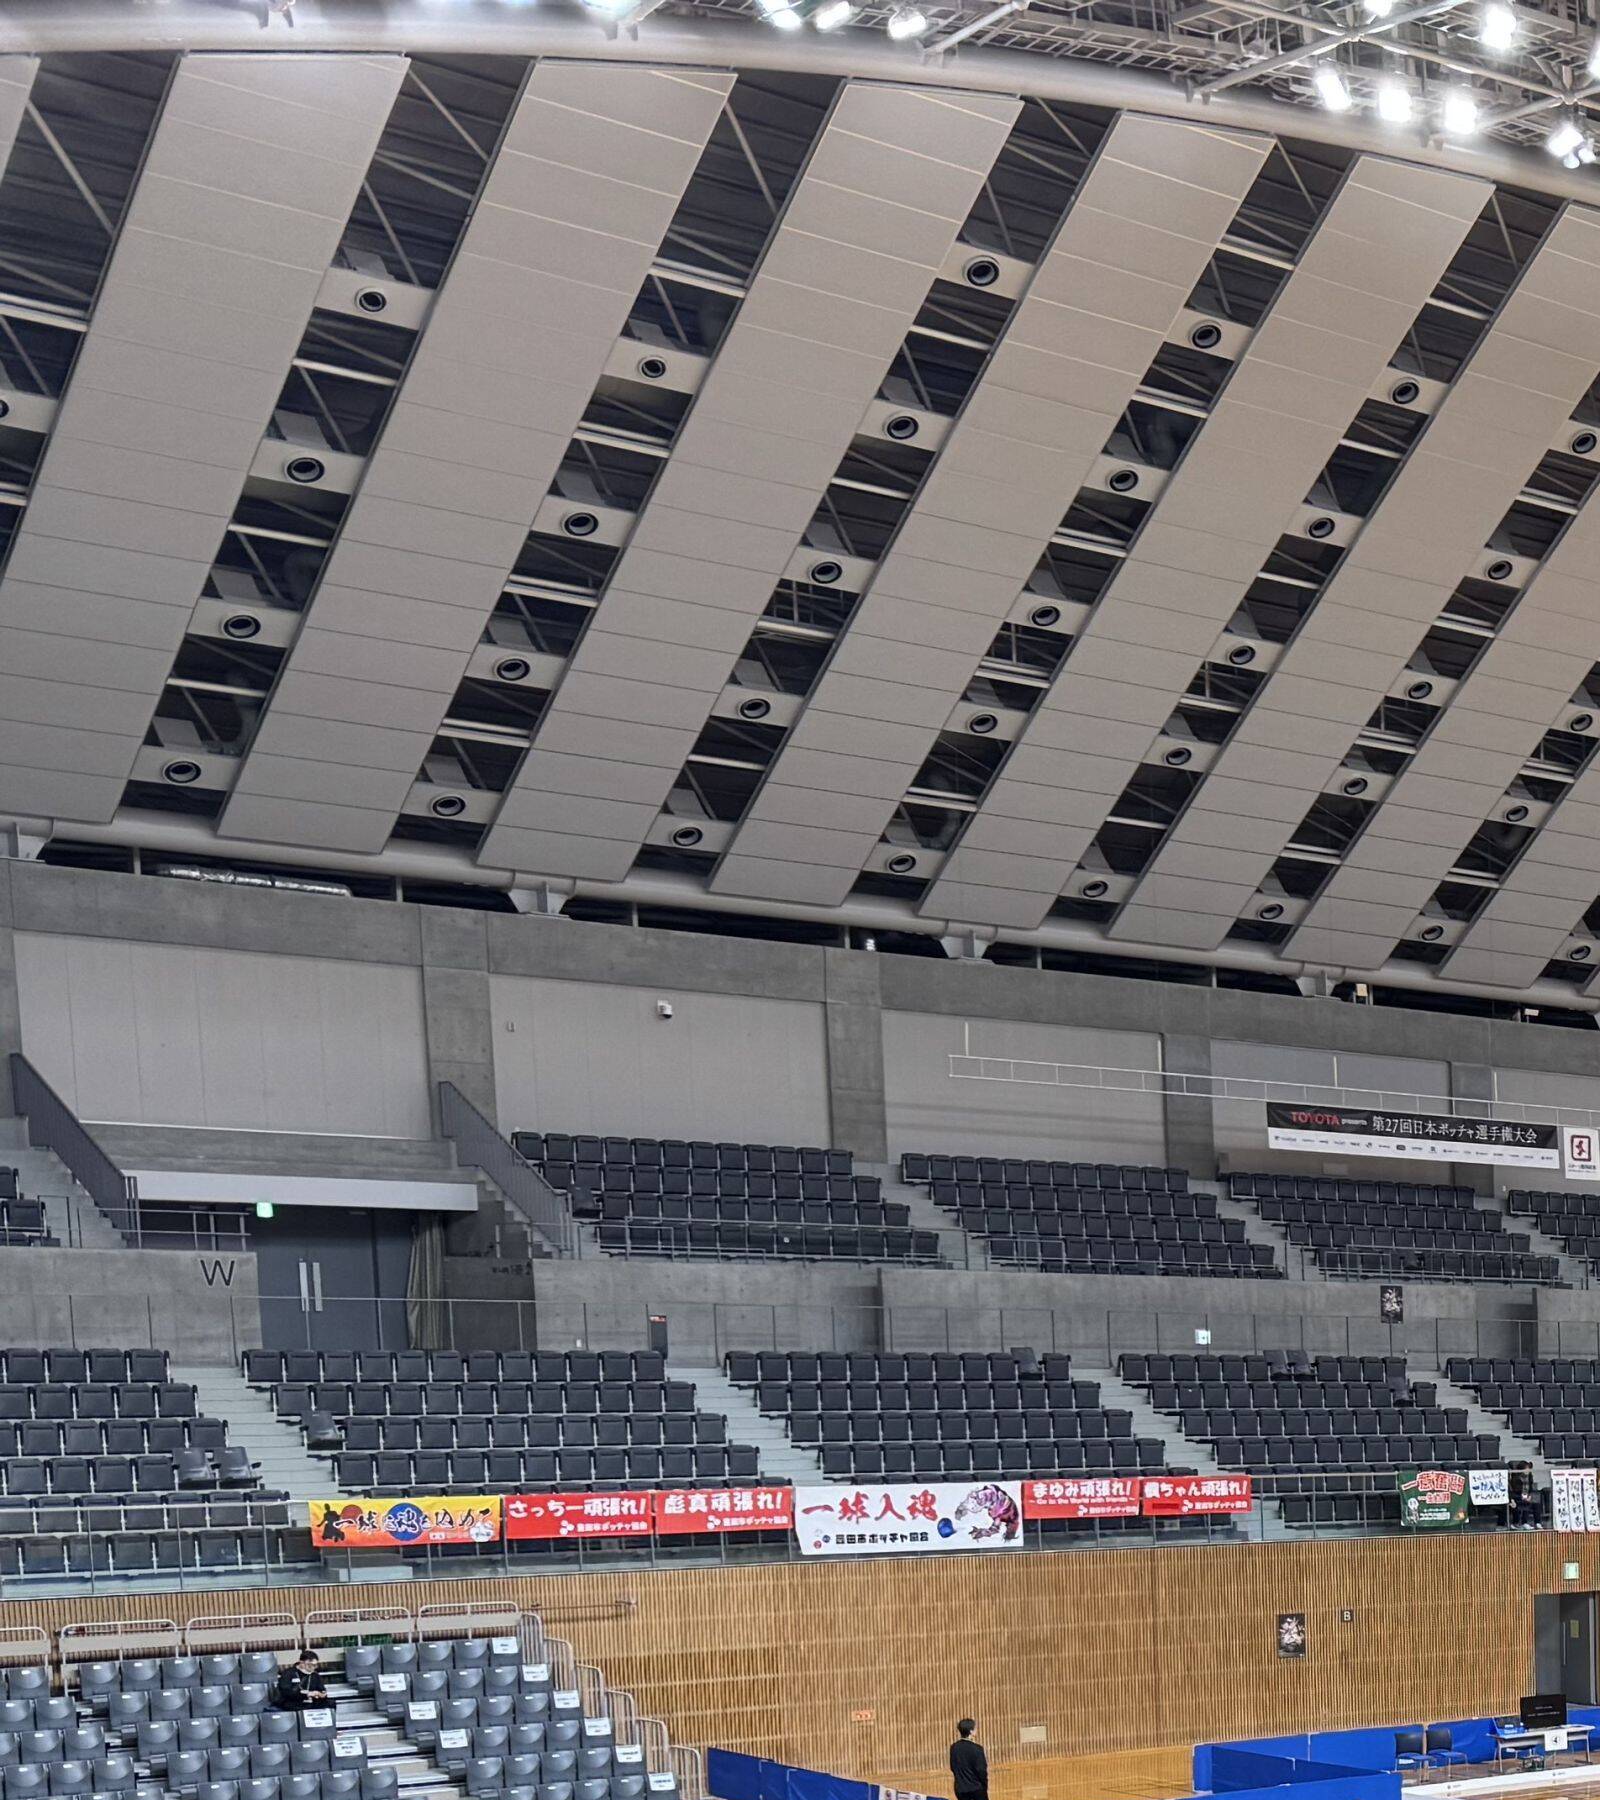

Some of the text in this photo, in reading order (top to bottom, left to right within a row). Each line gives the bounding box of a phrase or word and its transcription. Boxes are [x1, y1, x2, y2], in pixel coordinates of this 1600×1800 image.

[1289, 1110, 1342, 1127] TOYOTA
[1372, 1115, 1539, 1144] 第27回日本ボッチャ選手権大会
[200, 1259, 235, 1286] W
[801, 1488, 939, 1524] 一球入魂
